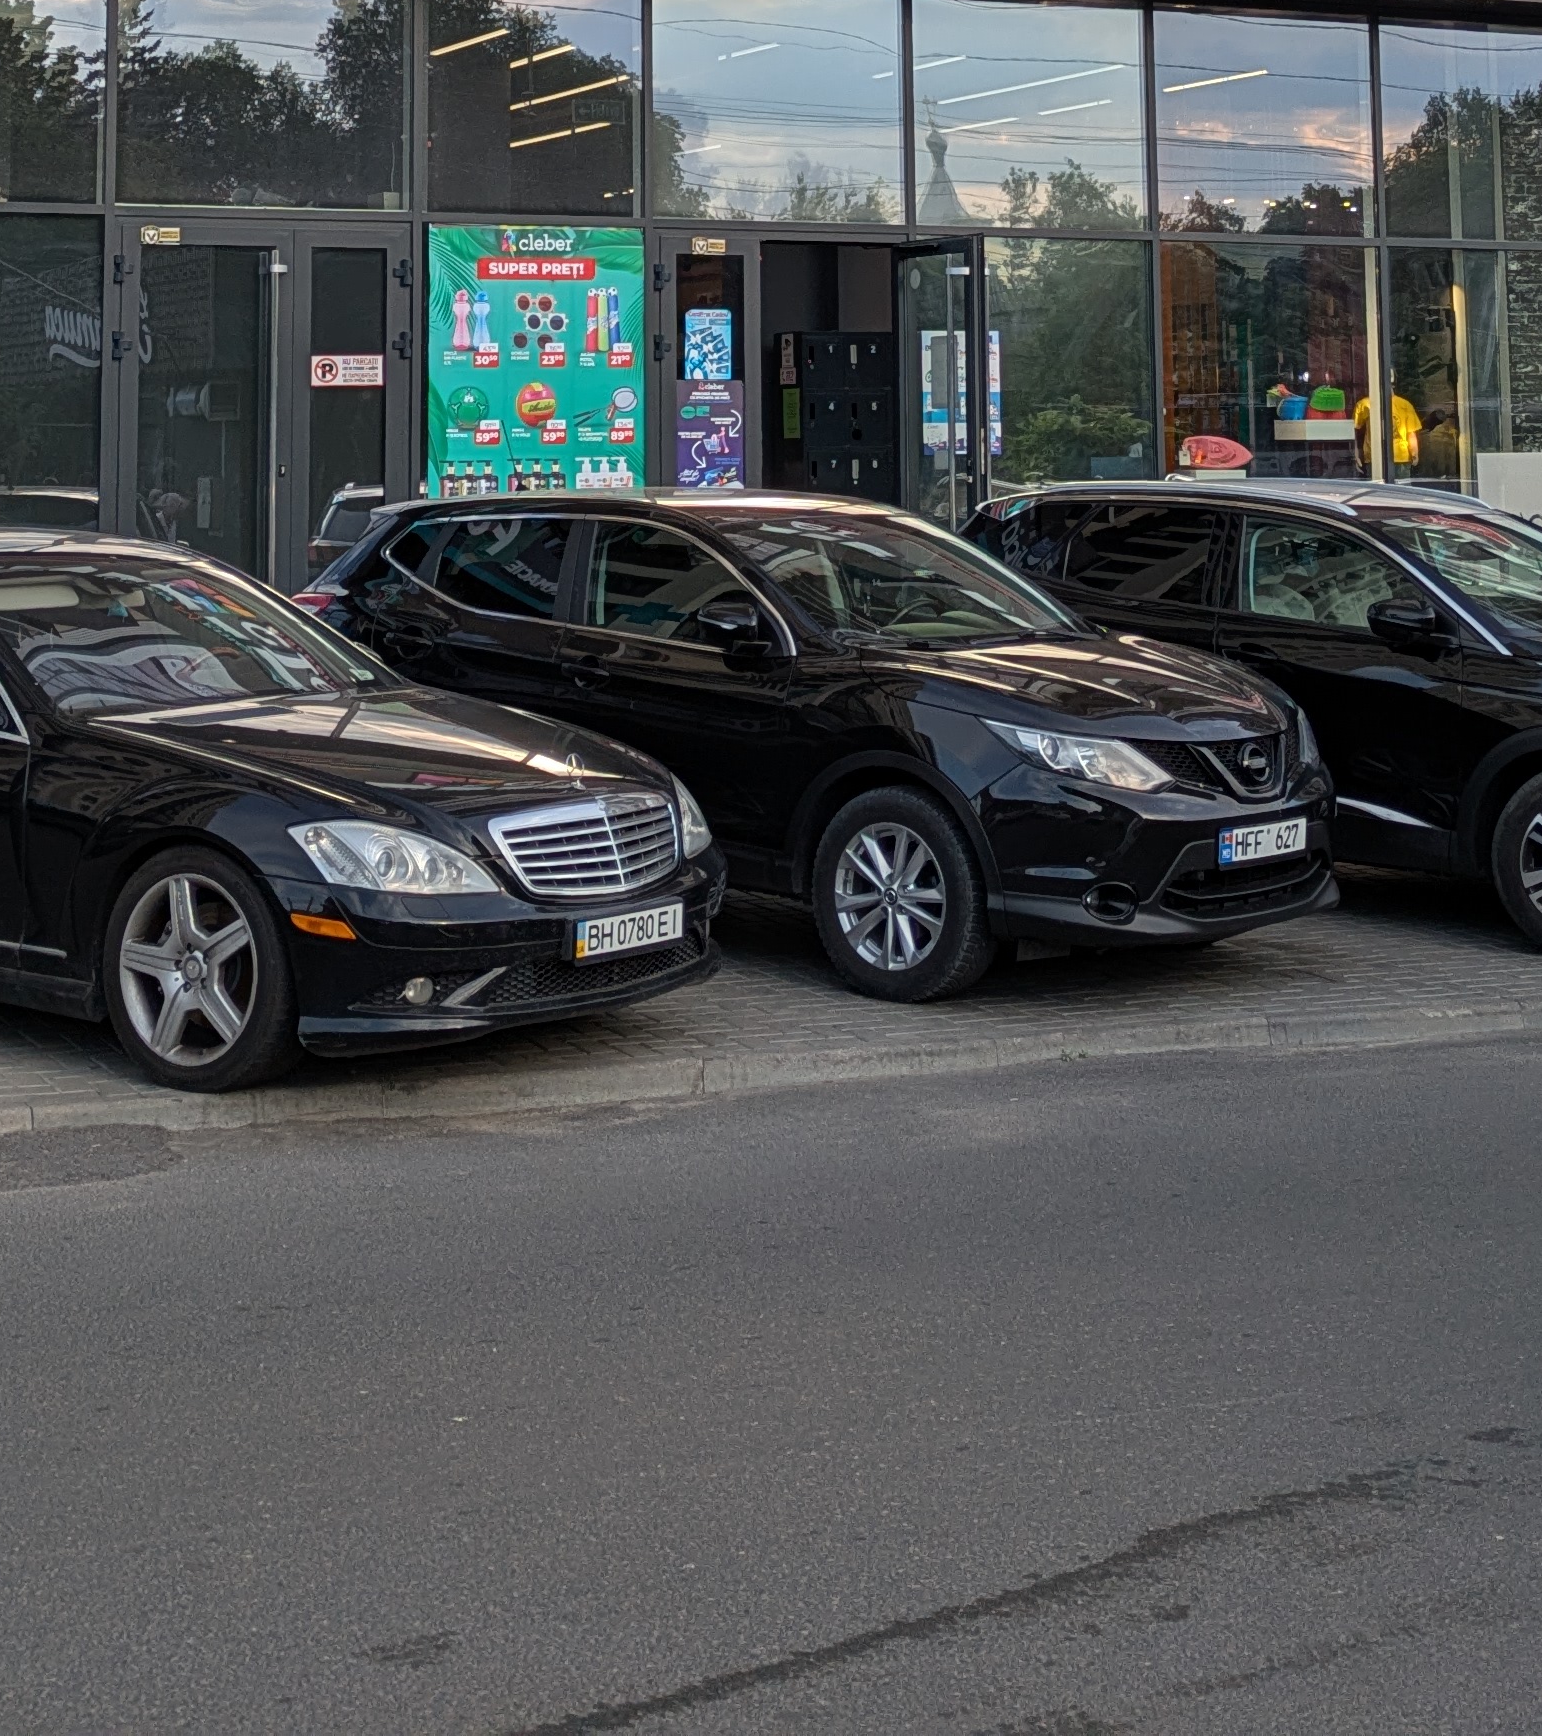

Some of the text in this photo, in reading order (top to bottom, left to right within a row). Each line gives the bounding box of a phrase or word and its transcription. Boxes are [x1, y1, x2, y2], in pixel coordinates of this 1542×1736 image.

[519, 234, 574, 251] cleber
[489, 263, 585, 278] SUPER PREȚ!
[1235, 823, 1299, 857] HFF 627
[588, 922, 613, 952] BH
[617, 914, 654, 945] 0780
